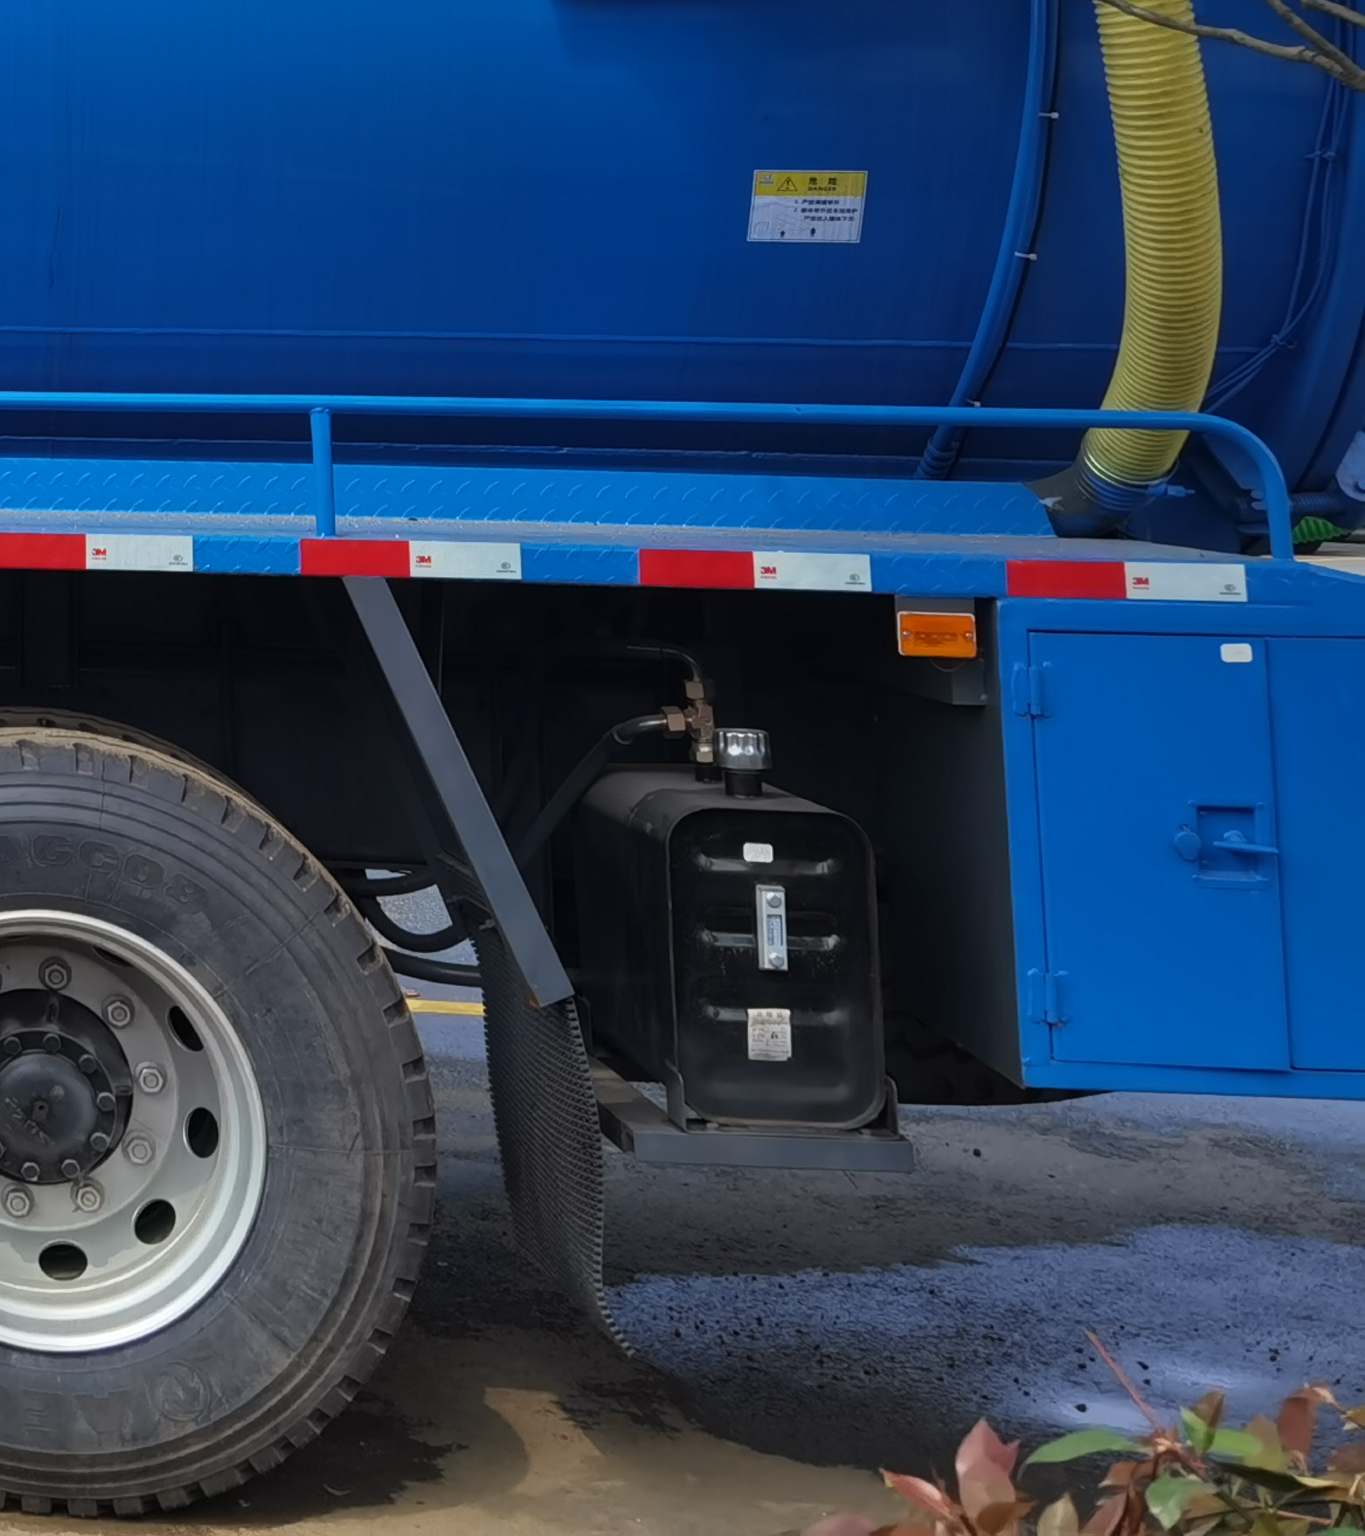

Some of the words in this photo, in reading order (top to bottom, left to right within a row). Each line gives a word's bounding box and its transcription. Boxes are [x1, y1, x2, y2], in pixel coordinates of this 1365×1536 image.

[92, 548, 107, 556] 3M
[415, 556, 431, 564] 3M
[760, 567, 777, 575] 3M
[1132, 577, 1150, 586] 3M
